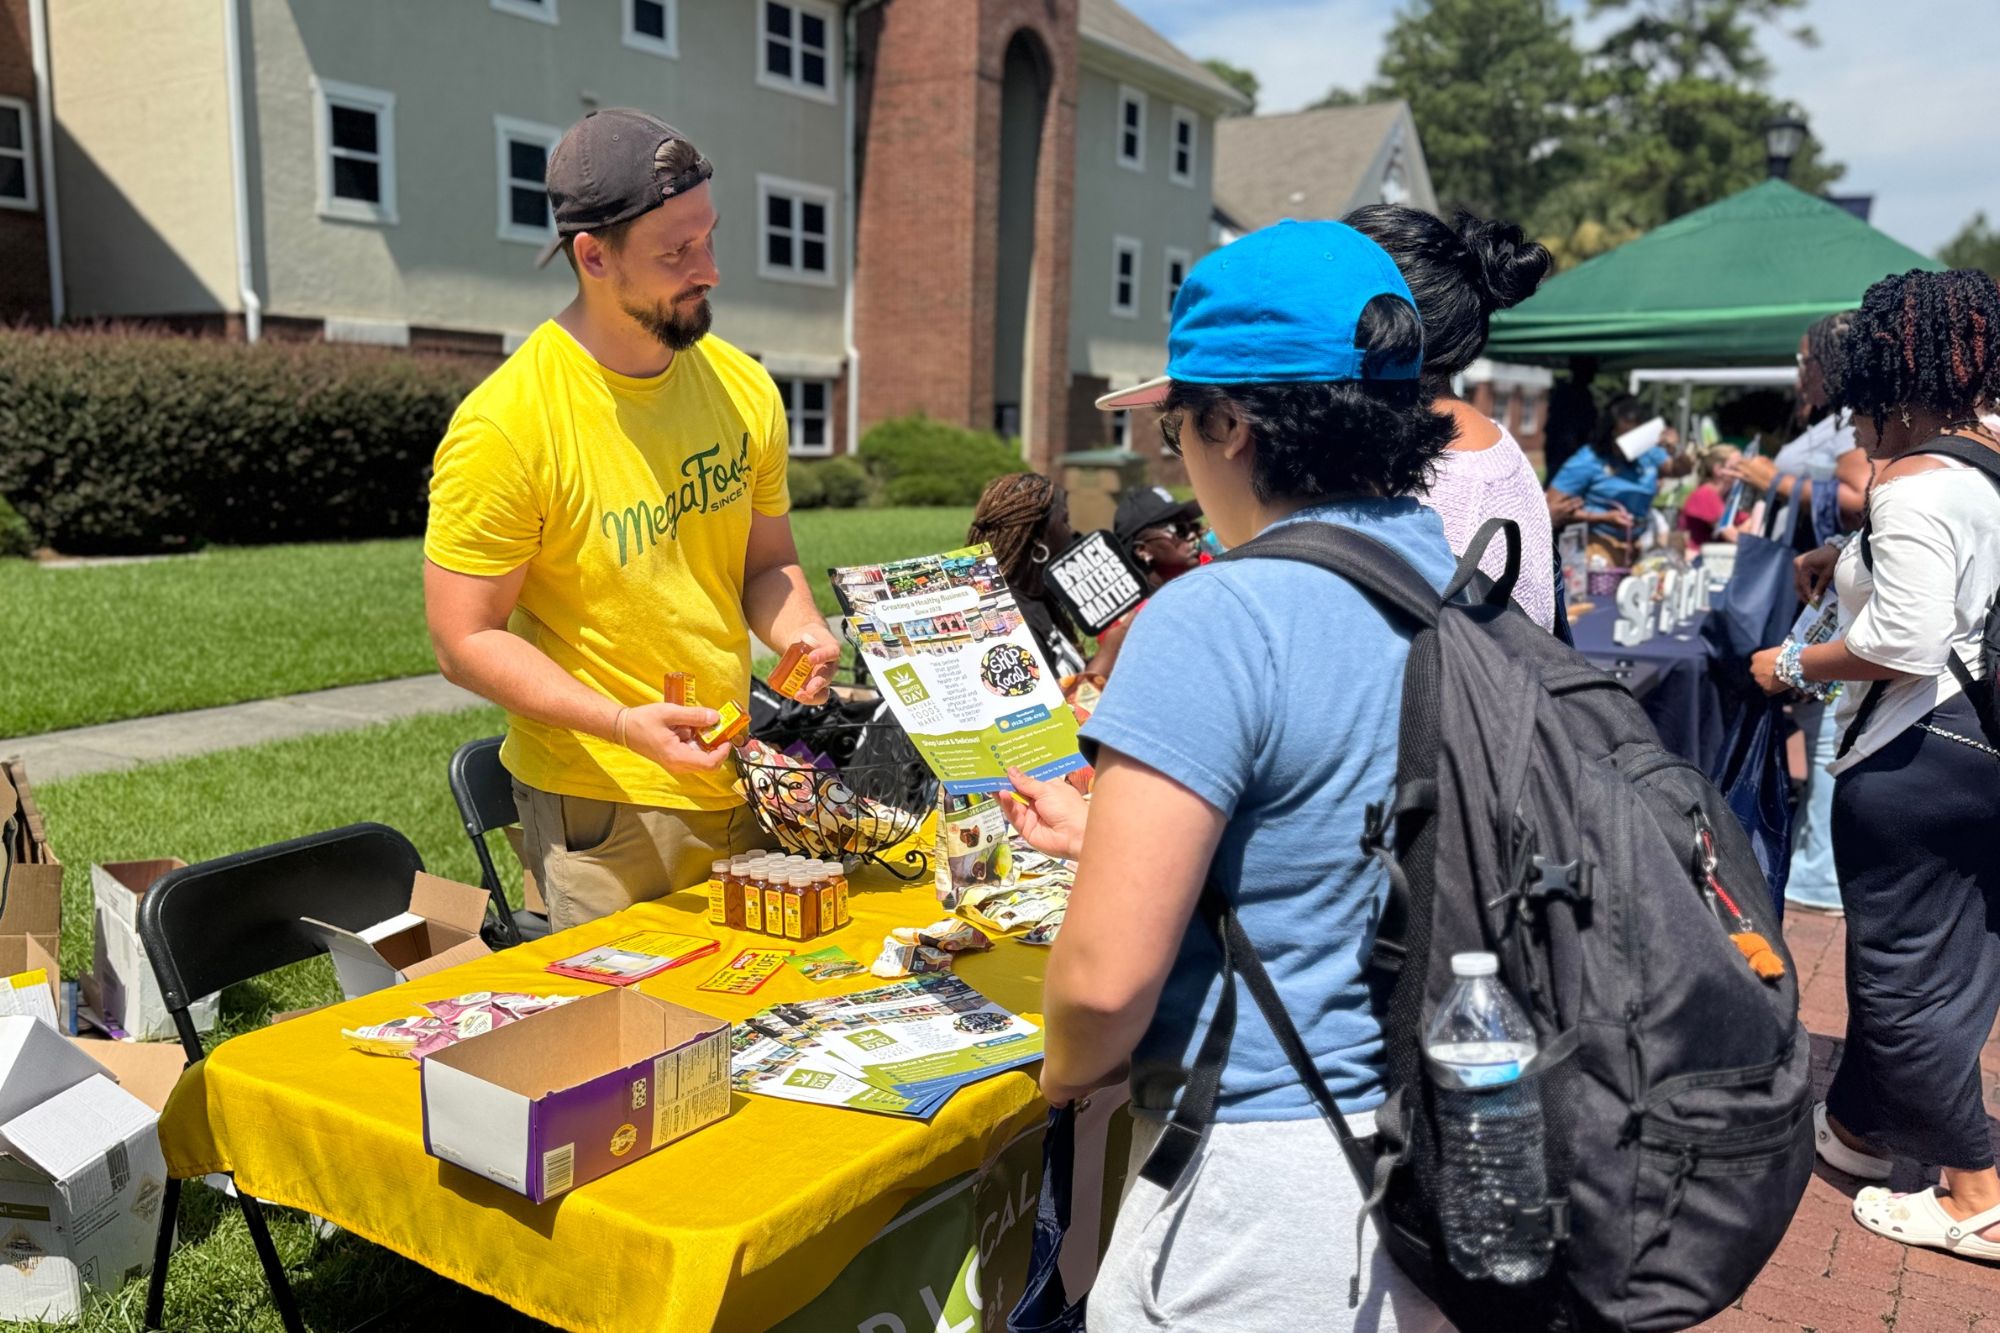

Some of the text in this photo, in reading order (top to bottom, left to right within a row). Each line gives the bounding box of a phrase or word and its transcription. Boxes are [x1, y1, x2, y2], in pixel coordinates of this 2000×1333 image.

[710, 488, 743, 512] SINCE
[1066, 555, 1127, 607] VOTERS
[914, 596, 940, 606] Healthy
[940, 591, 969, 602] Business
[1079, 572, 1140, 626] MATTER
[990, 649, 1019, 673] SHOP
[996, 666, 1030, 689] Local
[903, 689, 924, 704] DAY
[757, 954, 778, 968] OFF
[863, 1038, 891, 1050] DAY
